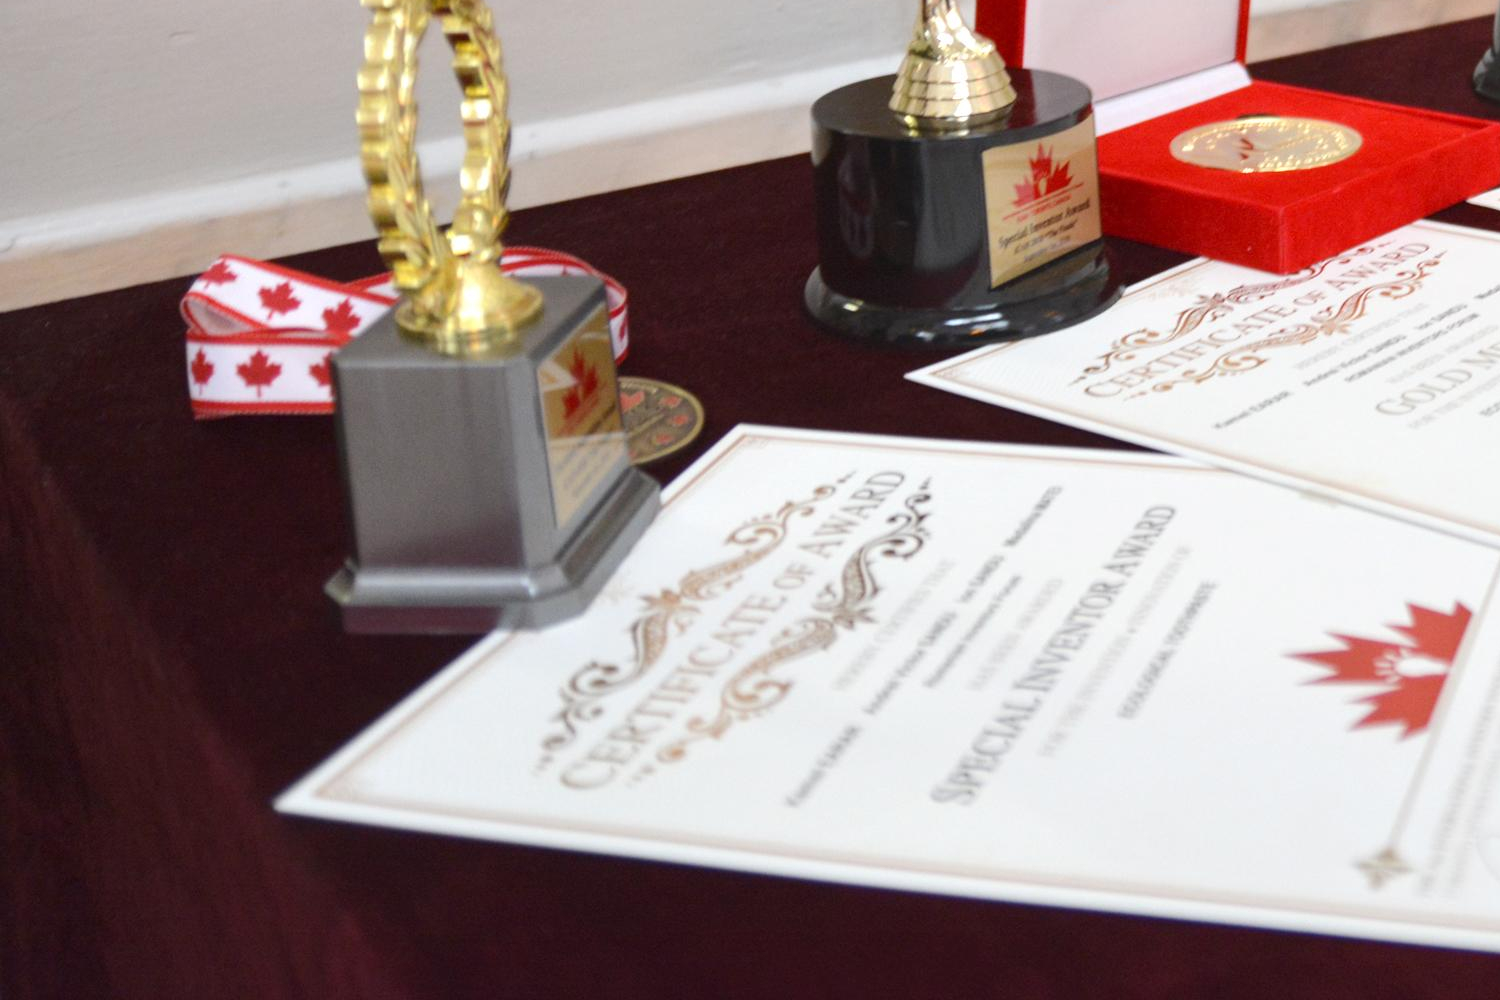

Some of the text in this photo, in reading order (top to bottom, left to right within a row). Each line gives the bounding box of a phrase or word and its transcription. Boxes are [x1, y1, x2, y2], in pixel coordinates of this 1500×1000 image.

[1084, 242, 1430, 398] CERTIFICATE OF AWARD
[1375, 368, 1472, 416] GOLD
[560, 470, 906, 789] CERTIFICATE OF AWARD
[929, 504, 1177, 806] SPECIAL INVENTOR AWARD
